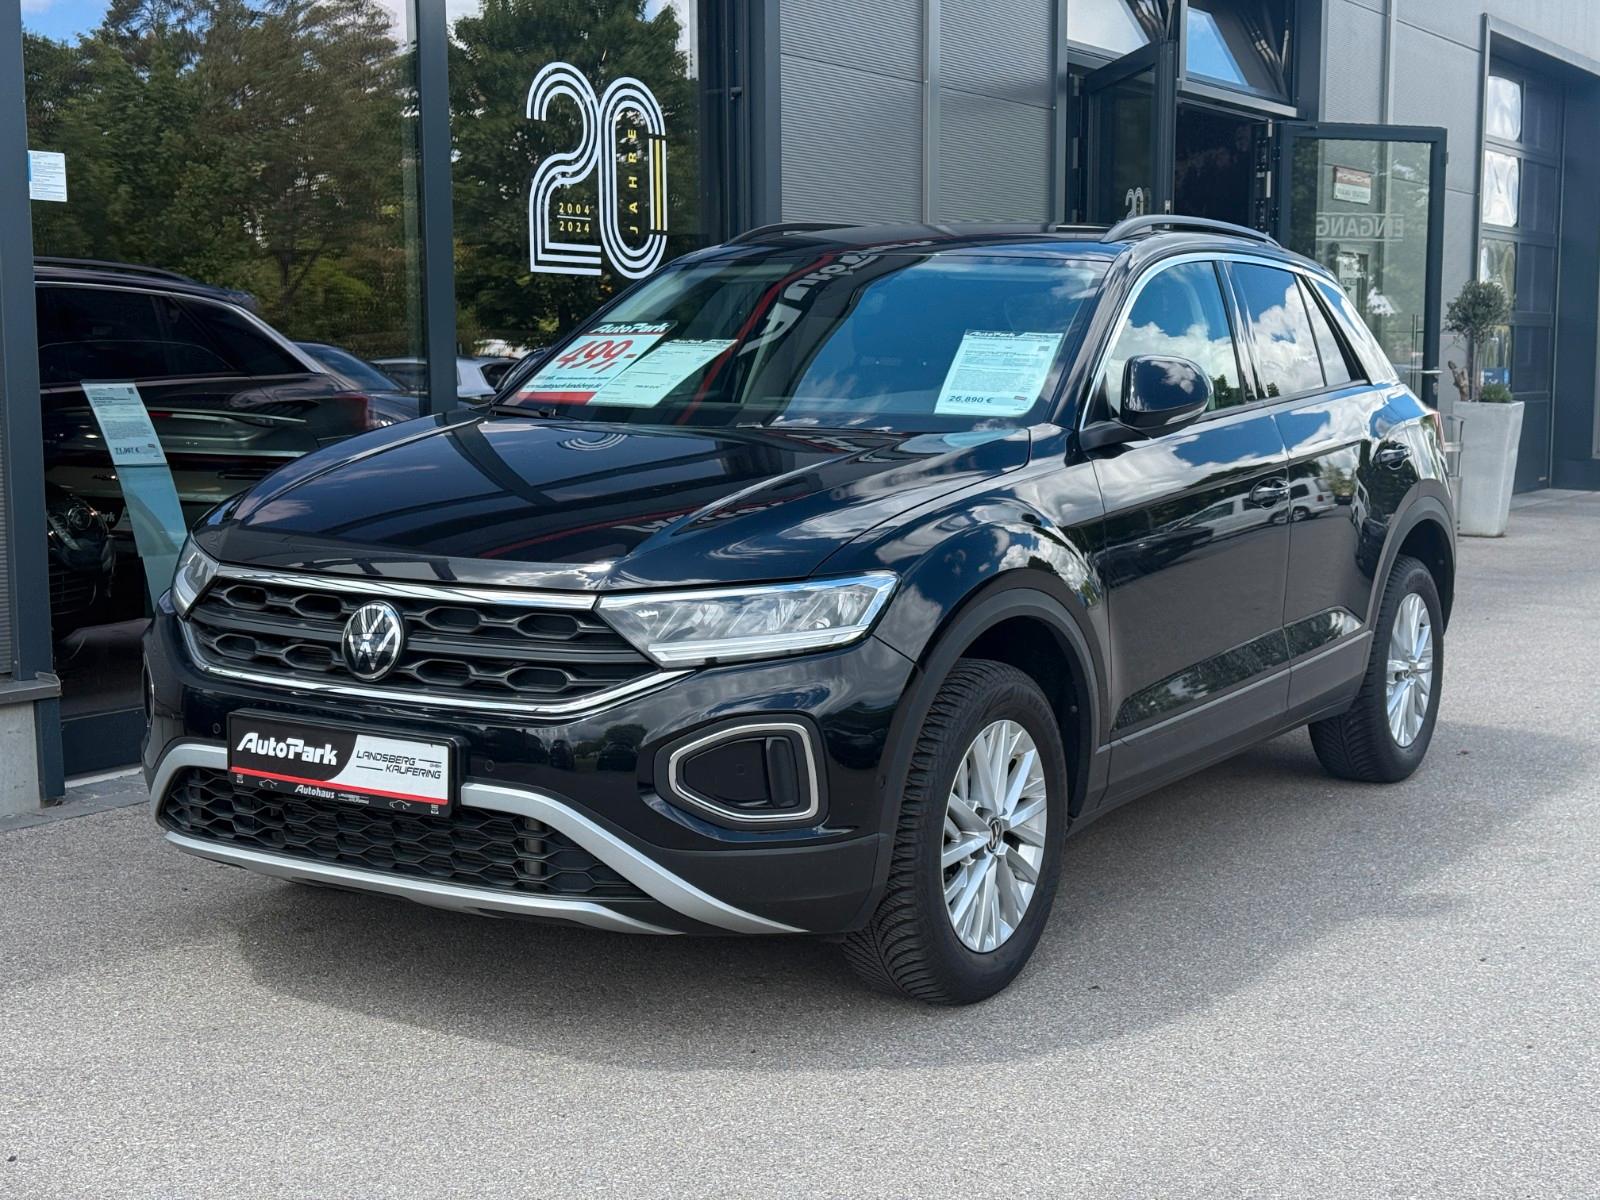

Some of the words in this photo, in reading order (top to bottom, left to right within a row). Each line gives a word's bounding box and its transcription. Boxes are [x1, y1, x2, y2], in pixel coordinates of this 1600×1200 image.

[526, 61, 668, 280] 20
[627, 128, 639, 235] JAHRE
[558, 202, 592, 216] 2004
[558, 220, 591, 233] 2024
[590, 322, 671, 334] AutoPark
[236, 732, 338, 766] AutoPark
[356, 750, 417, 766] LANDSBERG
[385, 765, 442, 780] KAUFERING
[294, 784, 335, 799] Autohaus
